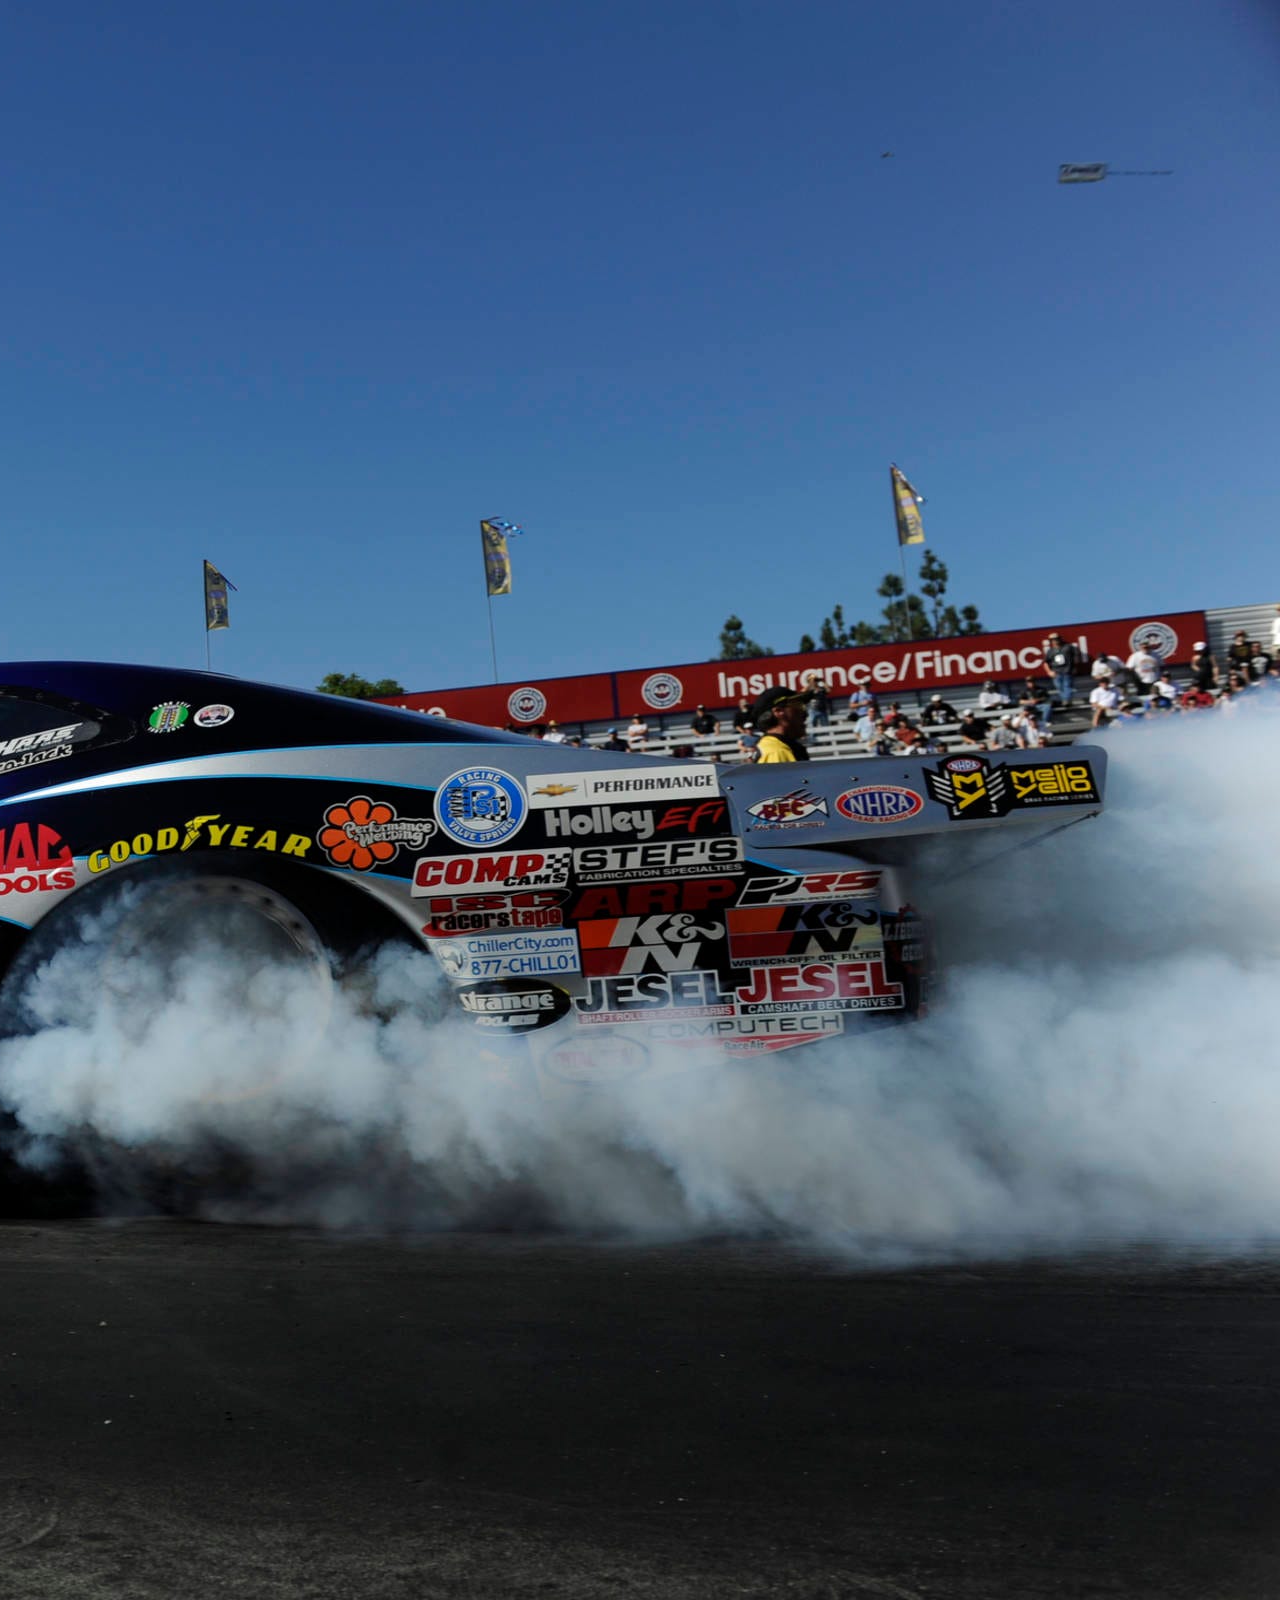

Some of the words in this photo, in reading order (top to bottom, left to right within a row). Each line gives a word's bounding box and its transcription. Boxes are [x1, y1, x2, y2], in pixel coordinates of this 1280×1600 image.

[950, 759, 979, 771] NHRA
[457, 772, 502, 785] RACING
[593, 774, 715, 793] PERFORMANCE
[849, 792, 911, 817] NHRA
[449, 820, 478, 842] VALVE
[479, 816, 517, 842] SPRINGS
[544, 807, 655, 839] Holley
[578, 838, 739, 871] STEF'S
[416, 853, 544, 888] COMP
[503, 872, 567, 887] CAMS
[578, 868, 661, 882] FABRICATION
[663, 863, 743, 876] SPECIALTIES
[570, 879, 737, 919] ARP
[467, 936, 575, 953] ChillerCity.com
[471, 954, 579, 976] 877-CHILL01
[818, 953, 838, 962] OIL
[841, 951, 882, 961] FILTER
[574, 971, 734, 1013] JESEL
[737, 962, 901, 1003] JESEL
[459, 990, 555, 1013] Strange
[703, 1006, 732, 1016] ARMS
[748, 1002, 817, 1015] CAMSHAFT
[819, 999, 848, 1010] BELT
[851, 996, 896, 1008] DRIVES
